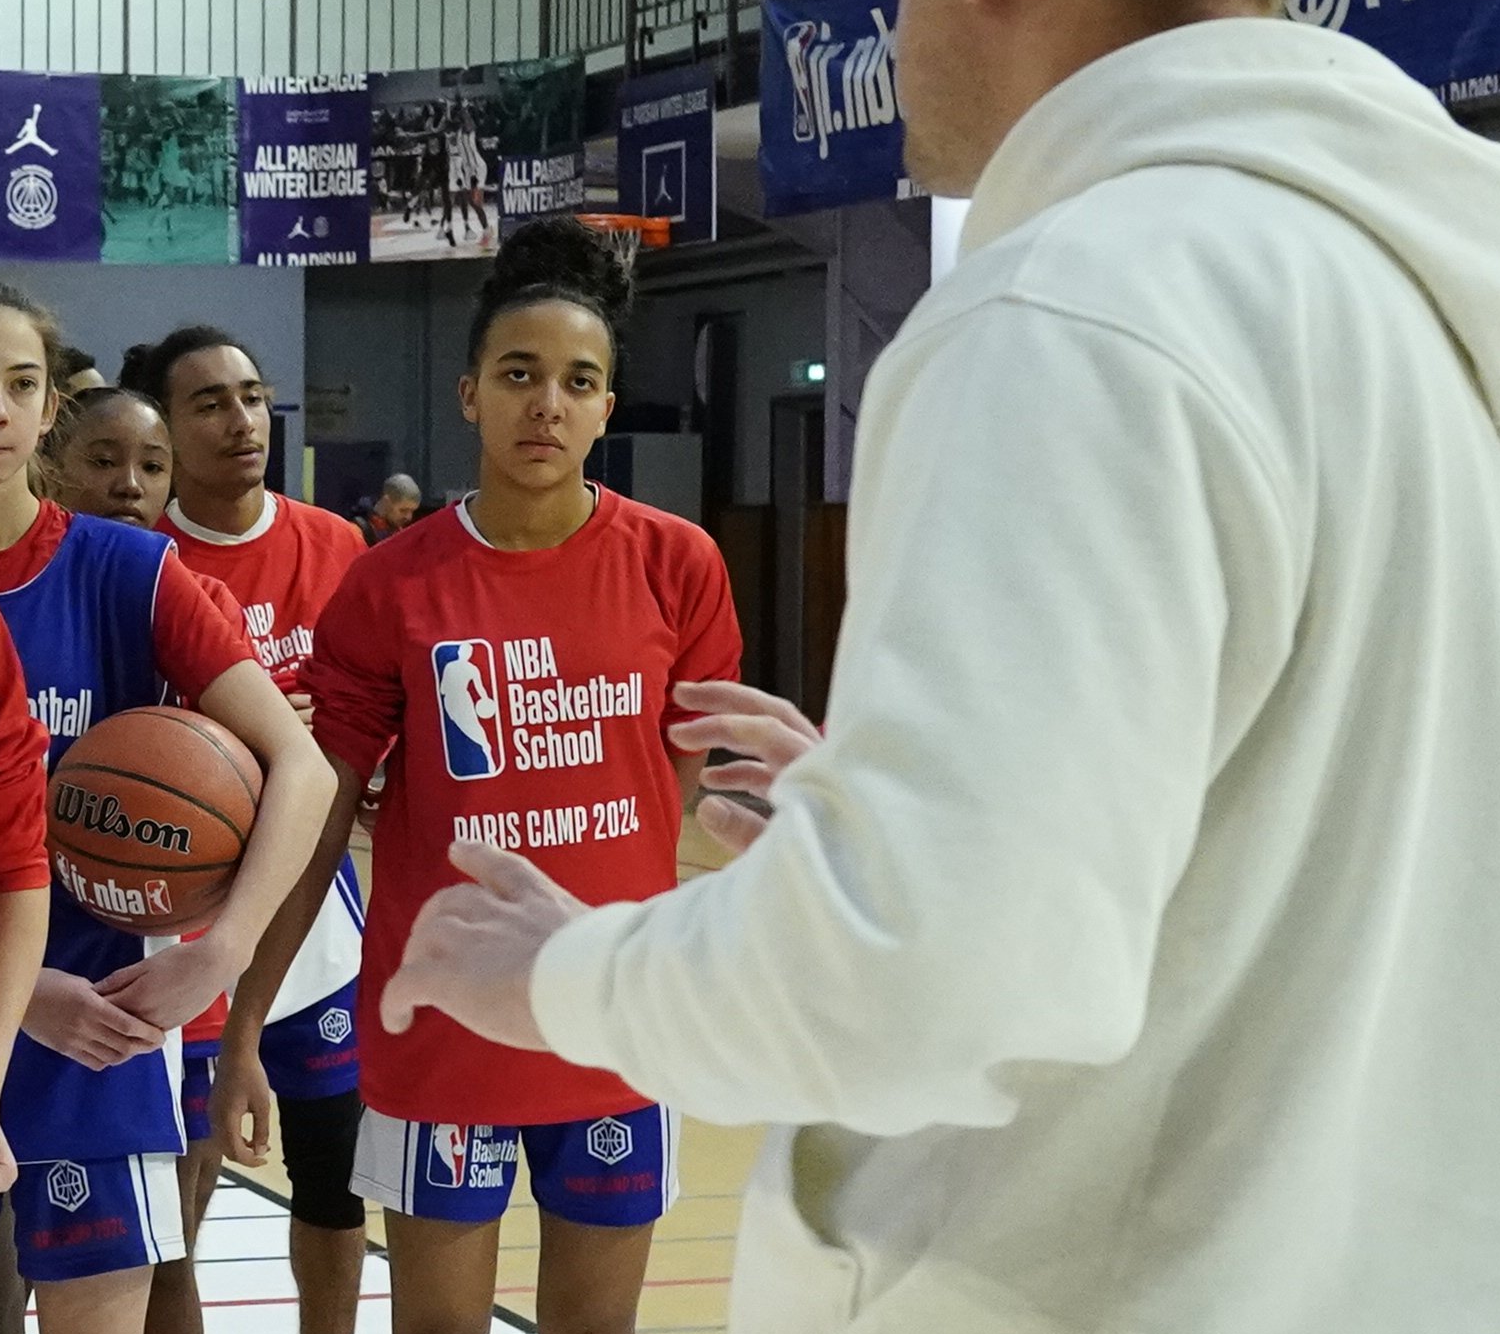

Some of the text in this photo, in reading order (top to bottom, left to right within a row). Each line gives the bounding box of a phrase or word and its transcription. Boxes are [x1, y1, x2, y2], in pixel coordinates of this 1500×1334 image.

[810, 8, 902, 160] jr.nb
[255, 145, 290, 171] ALL
[291, 143, 358, 171] PARISIAN
[503, 160, 531, 188] ALL
[244, 169, 367, 199] WINTER LEAGUE
[503, 187, 553, 215] WINTER
[503, 637, 558, 682] NBA
[507, 672, 642, 727] Basketball
[512, 720, 604, 772] School
[55, 781, 191, 855] Wilson
[526, 806, 589, 848] CAMP
[592, 796, 640, 841] 2024
[70, 864, 146, 916] jr.nba
